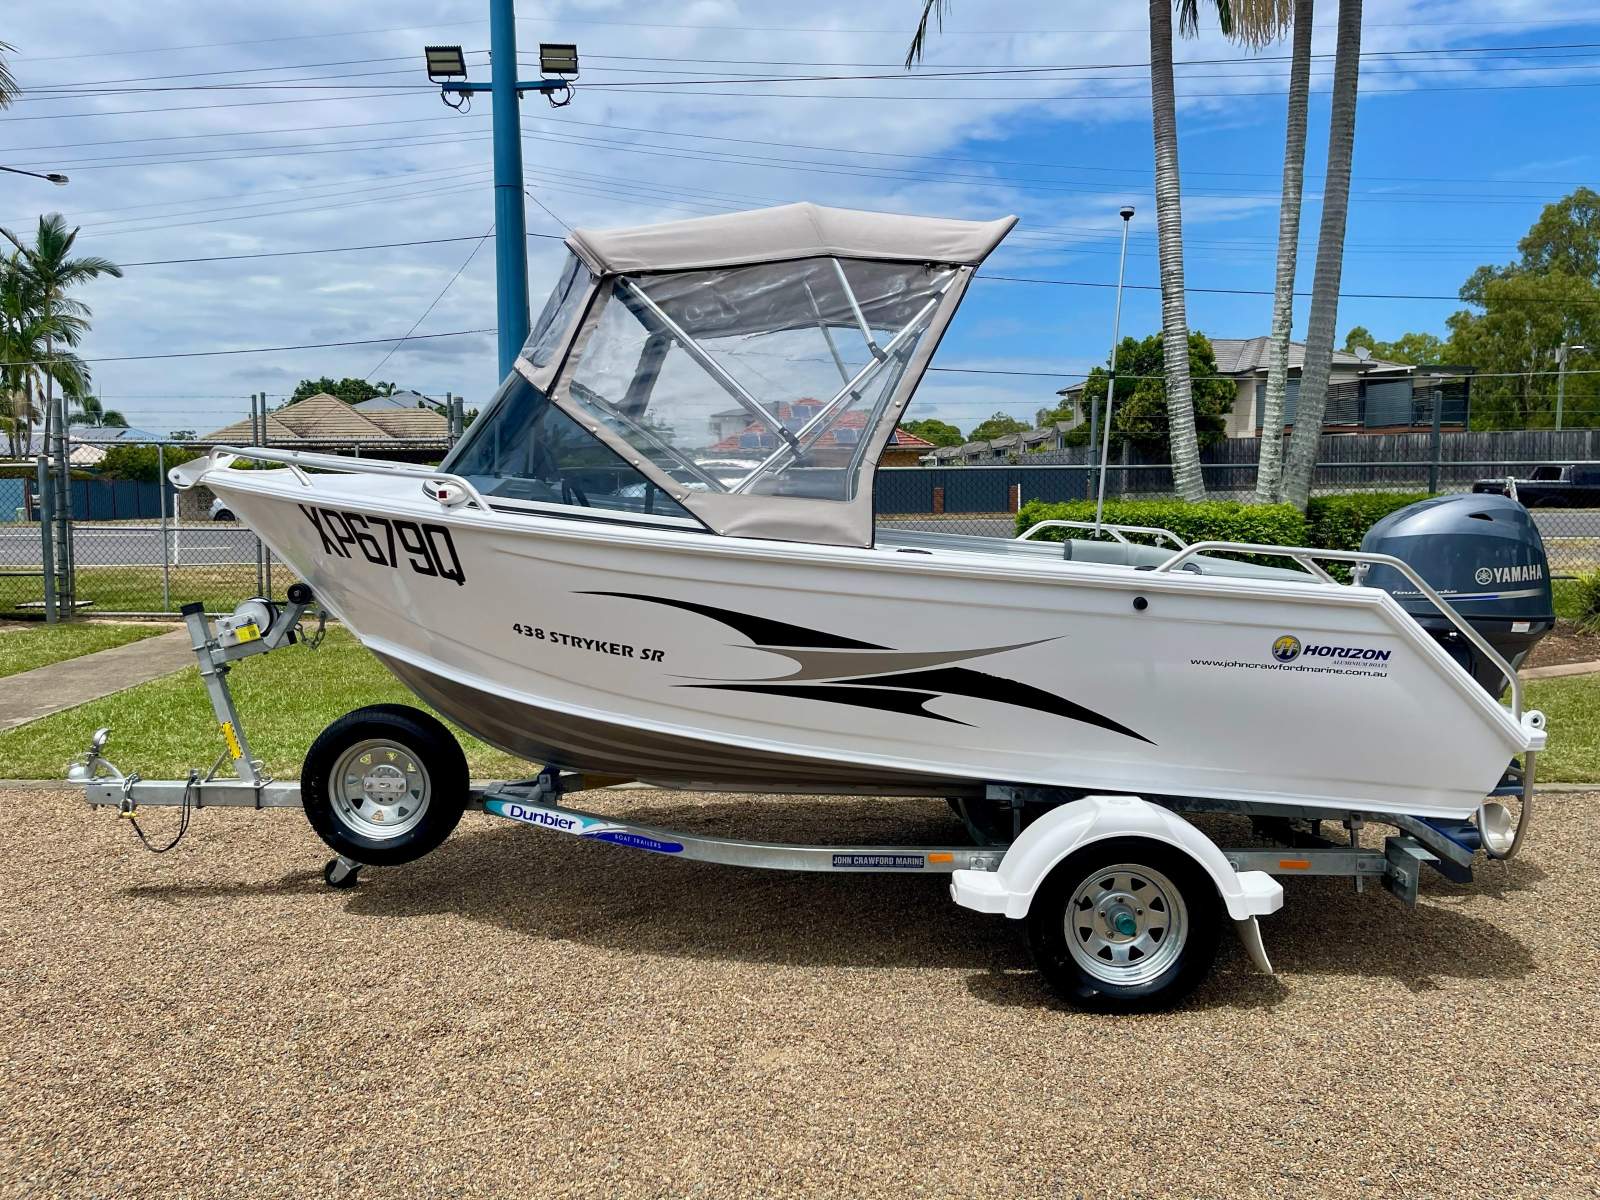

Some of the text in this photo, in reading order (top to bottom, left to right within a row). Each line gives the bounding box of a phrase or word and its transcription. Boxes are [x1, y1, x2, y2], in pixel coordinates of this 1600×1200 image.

[298, 503, 466, 586] XP679Q
[1493, 564, 1543, 583] YAMAHA
[512, 623, 665, 662] 438 STRYKER SR
[1303, 644, 1392, 661] HORIZON
[1190, 658, 1388, 678] www.johncrawfordmarine.com.au
[510, 805, 576, 830] Dunbier
[614, 834, 662, 849] BOAT TRAILERS
[833, 856, 924, 866] JOHN CRAWFORD MARINE
